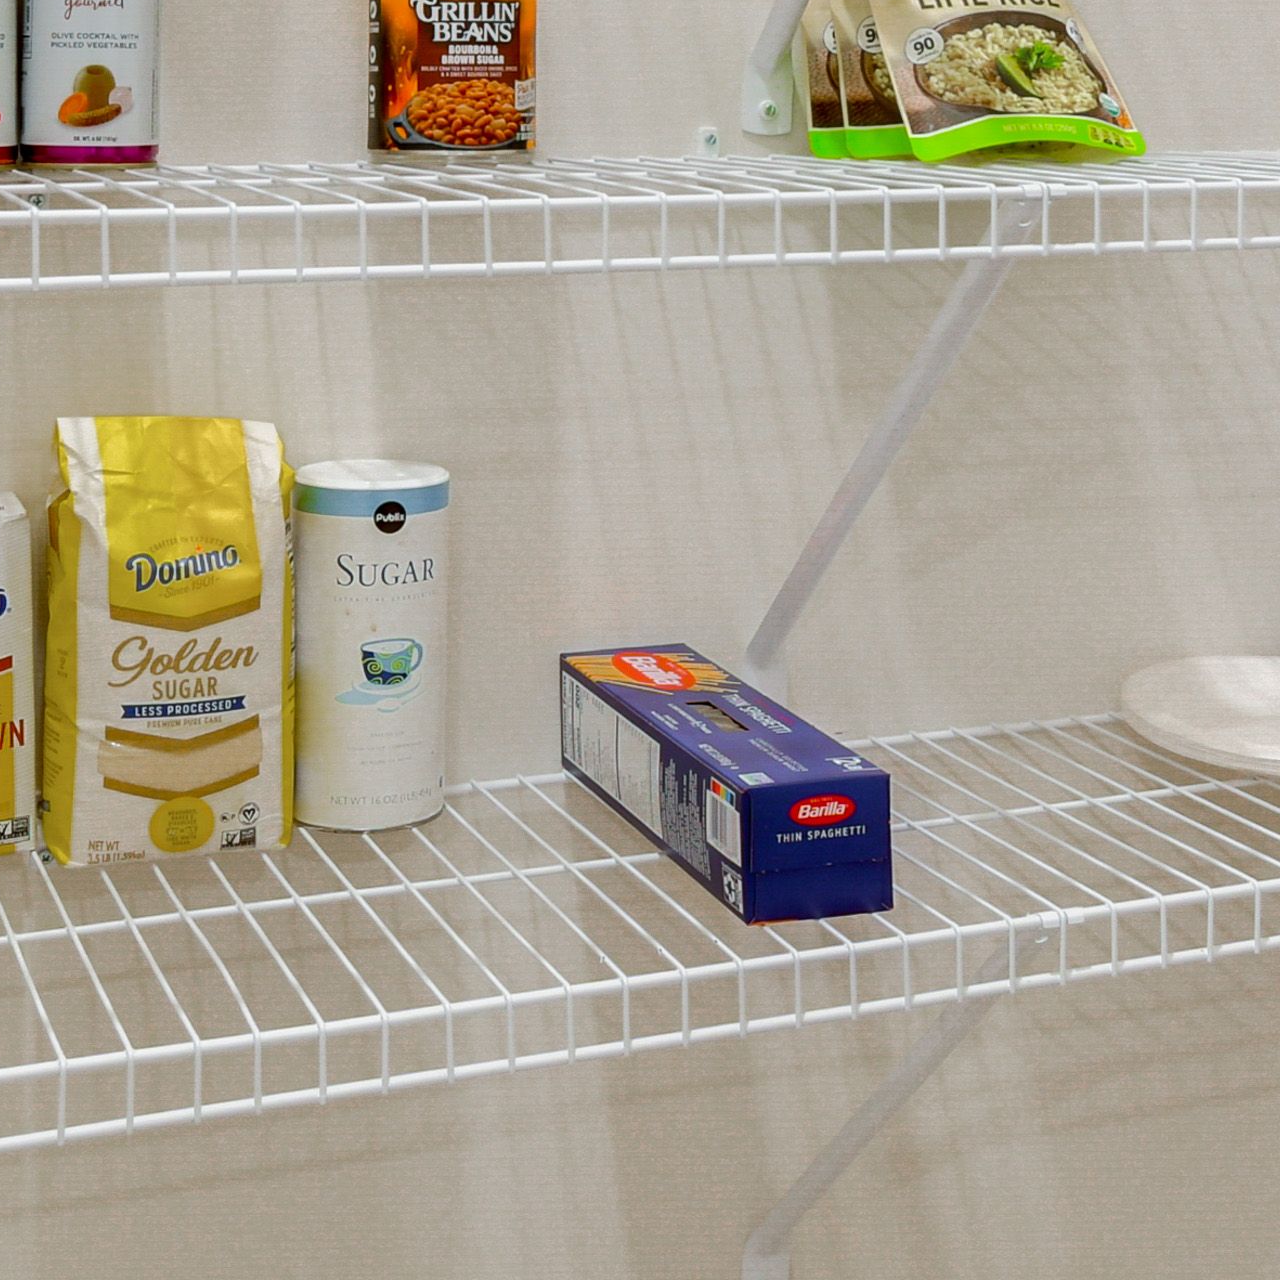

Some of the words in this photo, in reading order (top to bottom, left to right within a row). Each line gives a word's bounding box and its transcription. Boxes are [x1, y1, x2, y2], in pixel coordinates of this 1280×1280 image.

[432, 22, 515, 42] BEANS
[448, 45, 491, 54] BOURBON
[913, 36, 935, 56] 90
[441, 55, 475, 64] BROWN
[477, 55, 504, 64] SUGAR
[376, 511, 404, 522] Publix
[125, 545, 239, 592] Domino
[335, 553, 435, 589] SUGAR
[107, 636, 259, 688] Golden
[152, 676, 218, 701] SUGAR
[135, 706, 163, 717] LESS
[739, 703, 793, 734] SPAGHETTI
[147, 719, 181, 729] PREMIUM
[182, 717, 202, 727] PURE
[204, 715, 222, 724] CANE
[330, 795, 347, 805] NET
[351, 796, 367, 805] WT
[371, 796, 381, 805] 16
[383, 794, 399, 804] OZ
[798, 801, 846, 819] Barilla
[775, 831, 802, 844] THIN
[807, 825, 866, 841] SPAGHETTI
[88, 840, 104, 852] NET
[106, 840, 120, 851] WT
[102, 853, 111, 863] LB
